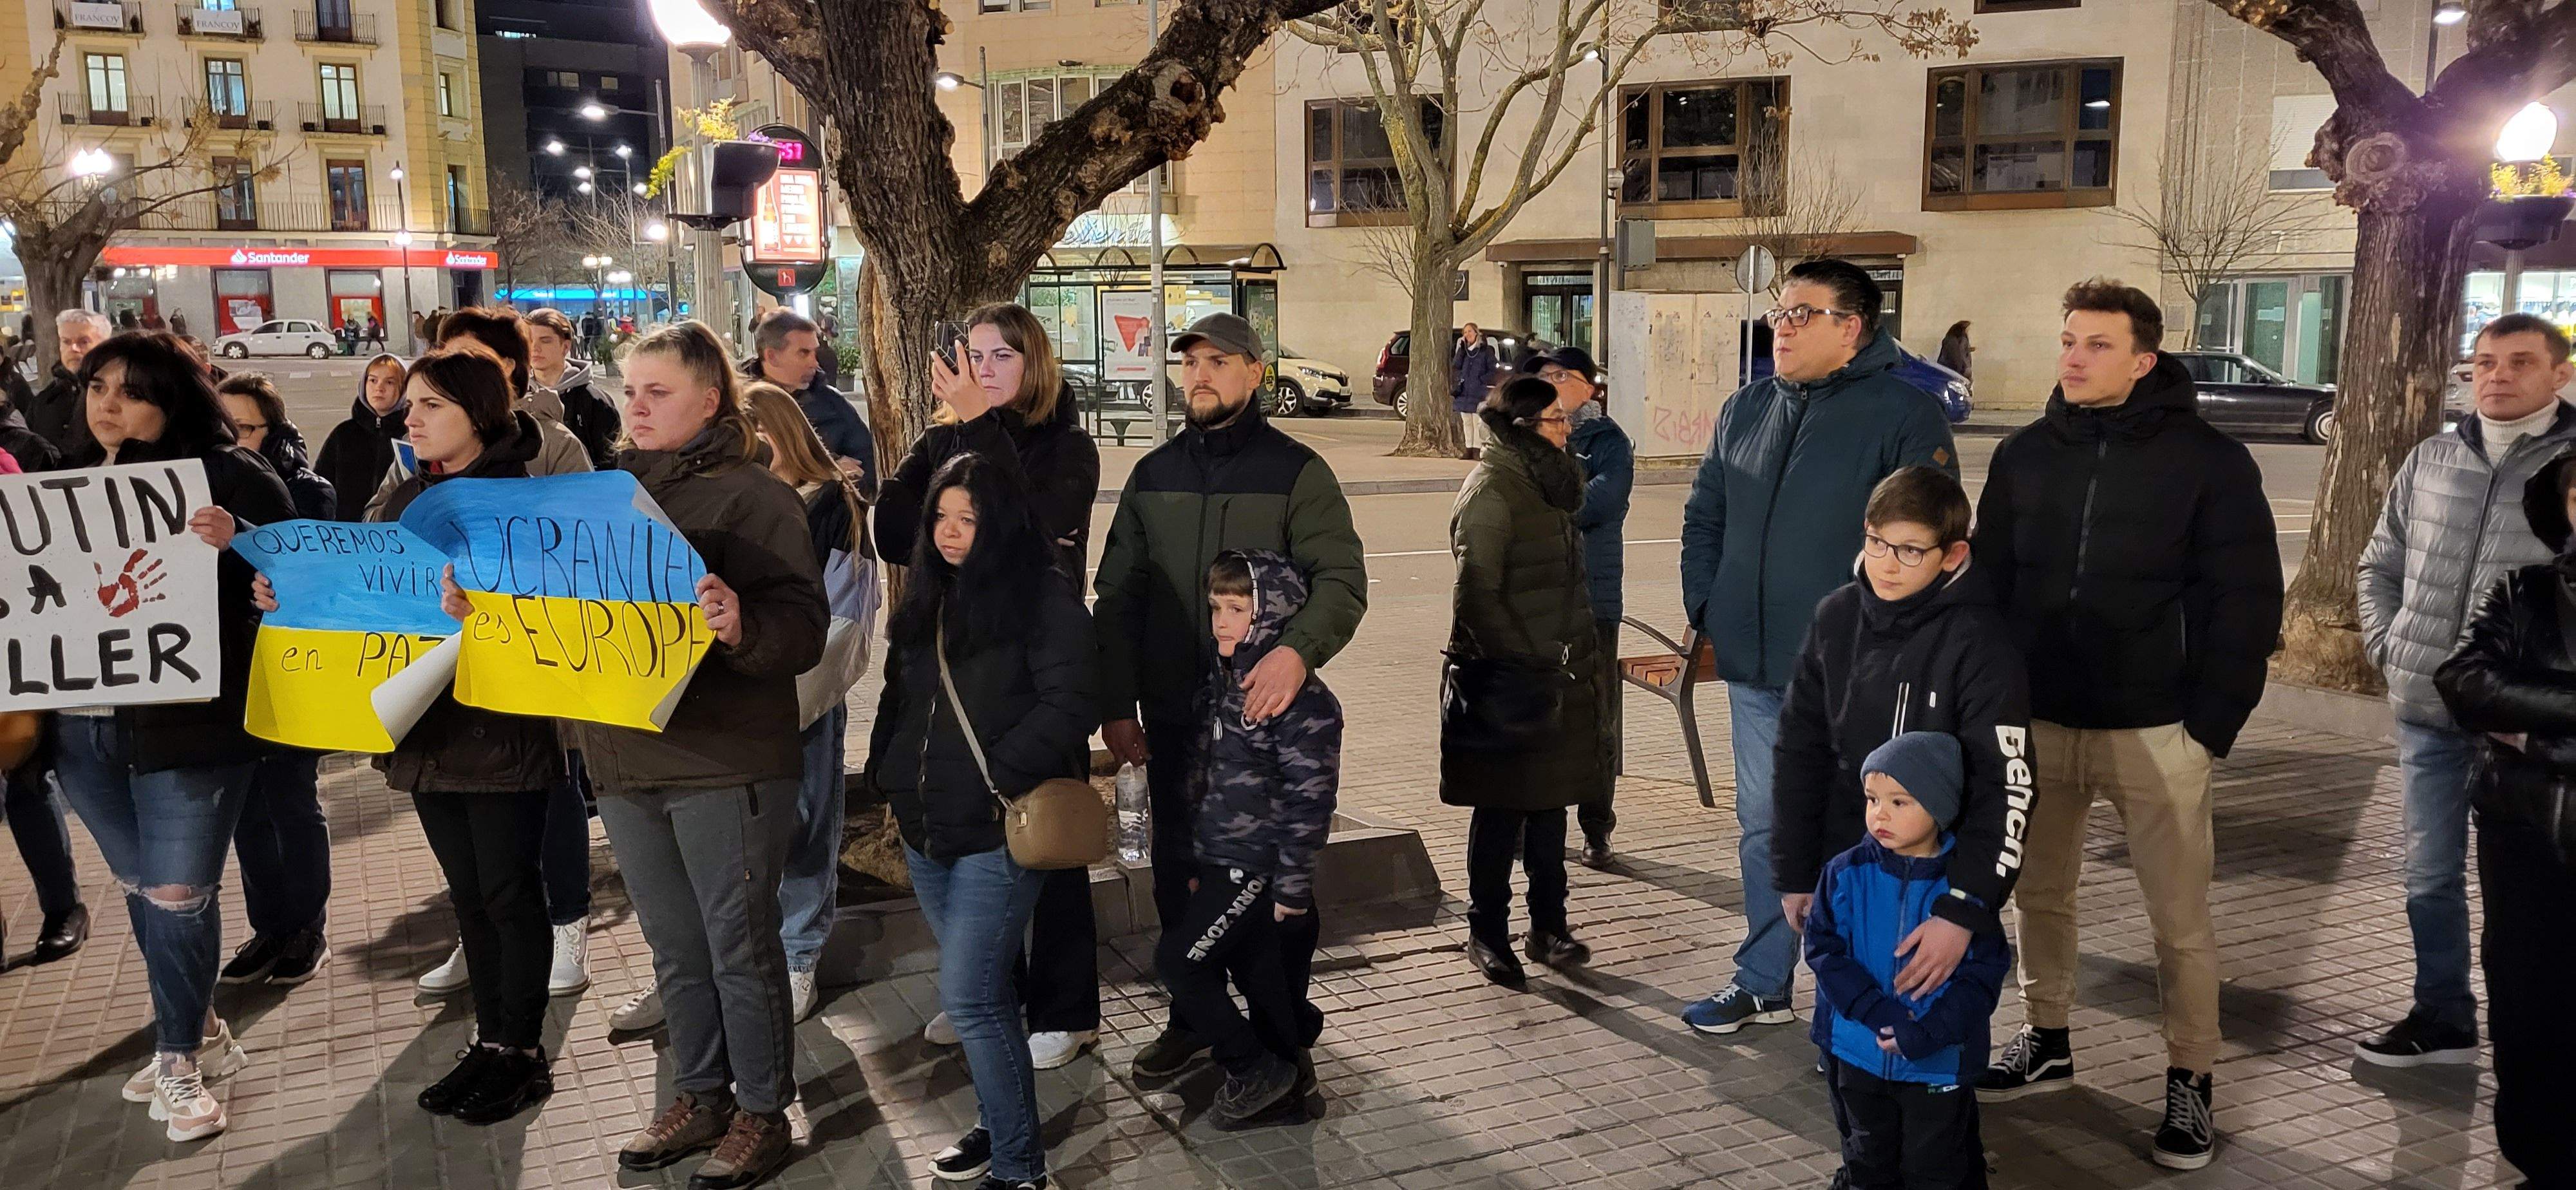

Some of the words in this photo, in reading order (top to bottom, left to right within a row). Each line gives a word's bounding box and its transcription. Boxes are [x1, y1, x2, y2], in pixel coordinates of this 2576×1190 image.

[248, 252, 309, 263] Santander
[253, 524, 405, 554] QUEREMOS
[27, 565, 67, 614] A
[473, 610, 511, 644] es
[281, 647, 323, 672] en
